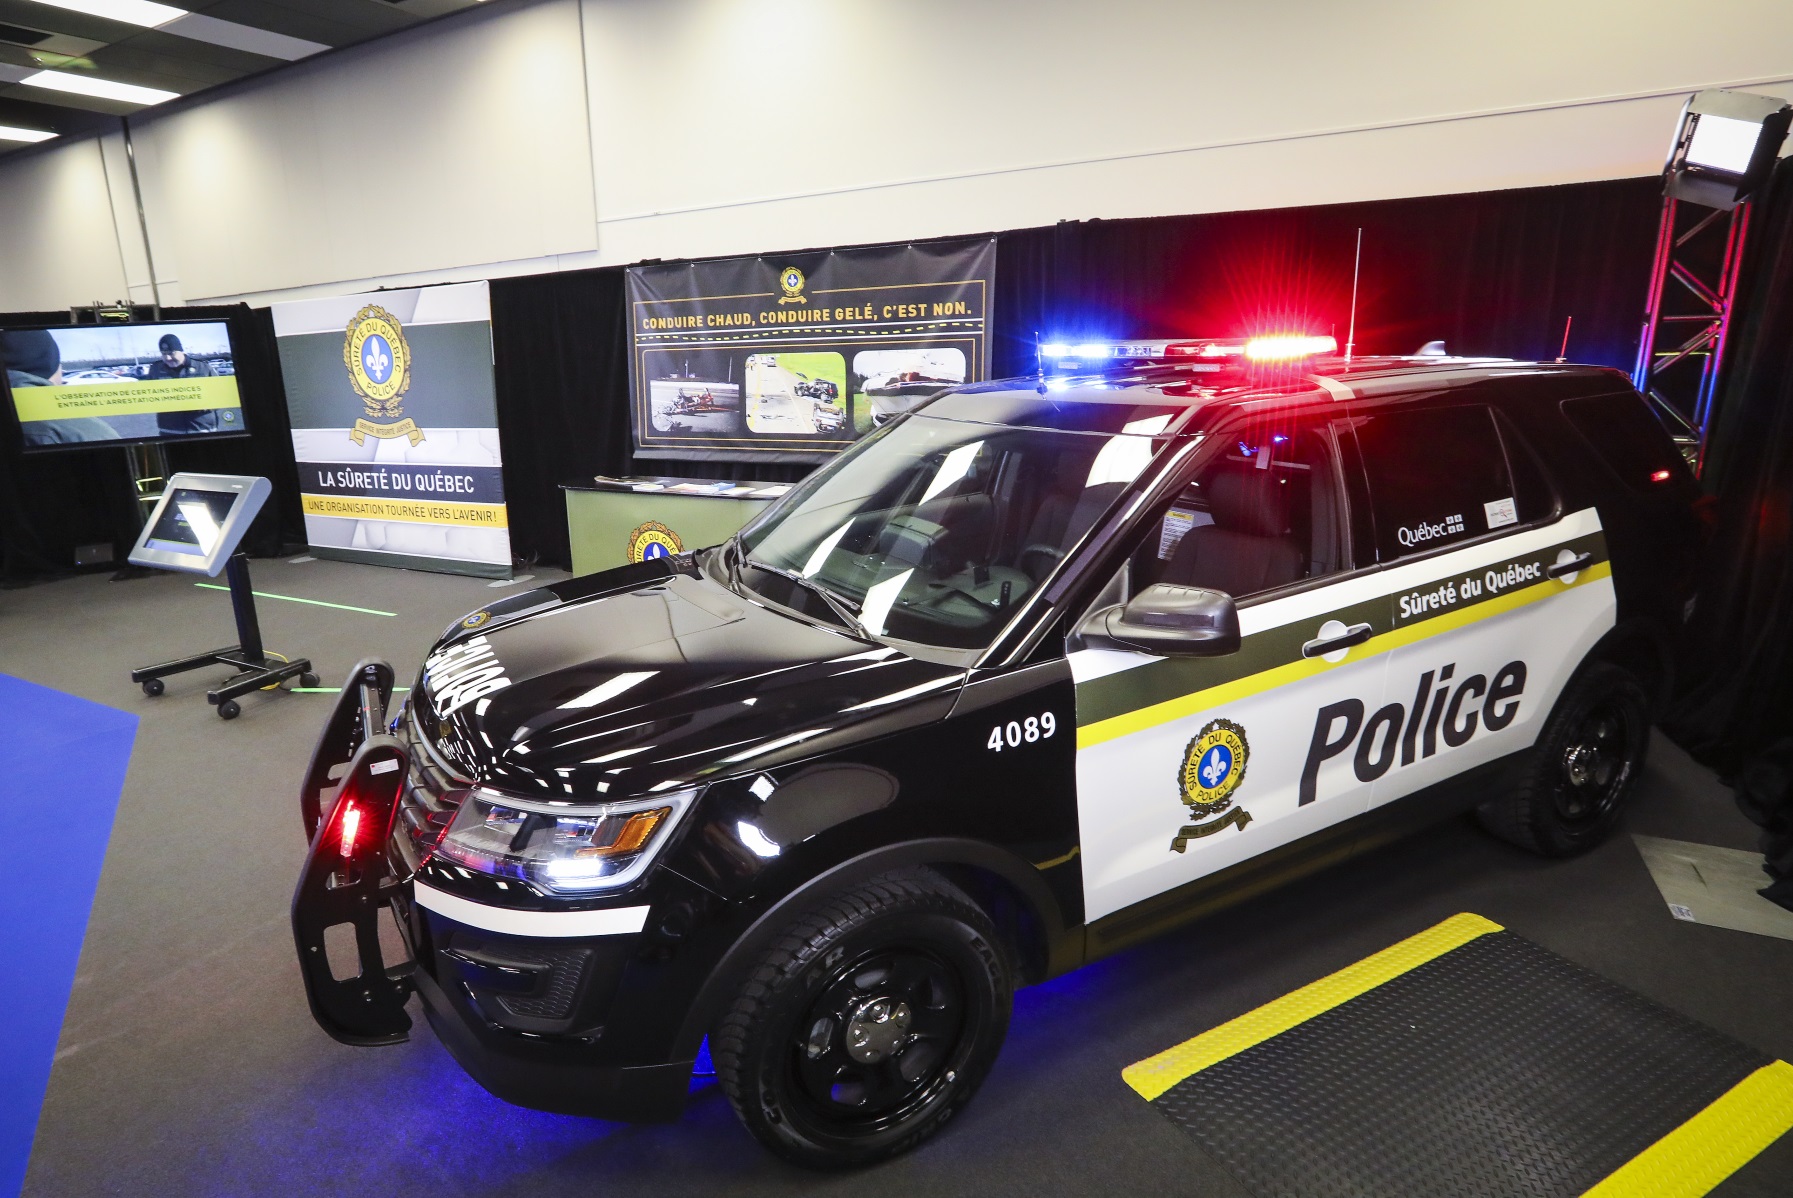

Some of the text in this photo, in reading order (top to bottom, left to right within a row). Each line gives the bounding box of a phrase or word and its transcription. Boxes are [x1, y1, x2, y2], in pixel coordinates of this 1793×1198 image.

[365, 321, 378, 333] DU
[643, 301, 972, 330] CONDUIRE CHAUD, CONDUIRE GELÉ, C'EST NON.
[131, 386, 170, 396] CERTAINS
[171, 385, 202, 393] INDICES
[366, 380, 396, 397] POLICE
[318, 467, 475, 494] LA SÛRETÉ DU QUÉBEC
[308, 500, 325, 511] UNE
[326, 501, 384, 515] ORGANISATION
[385, 503, 425, 518] TOURNÉE
[427, 507, 451, 520] VERS
[649, 533, 660, 541] DU
[1397, 521, 1447, 547] Québec
[1399, 561, 1541, 619] Sûreté du Québec
[987, 711, 1056, 752] 4089
[1298, 660, 1527, 808] Police
[1208, 731, 1222, 745] DU
[1225, 734, 1243, 776] QUÉBEC
[1195, 780, 1231, 802] POLICE
